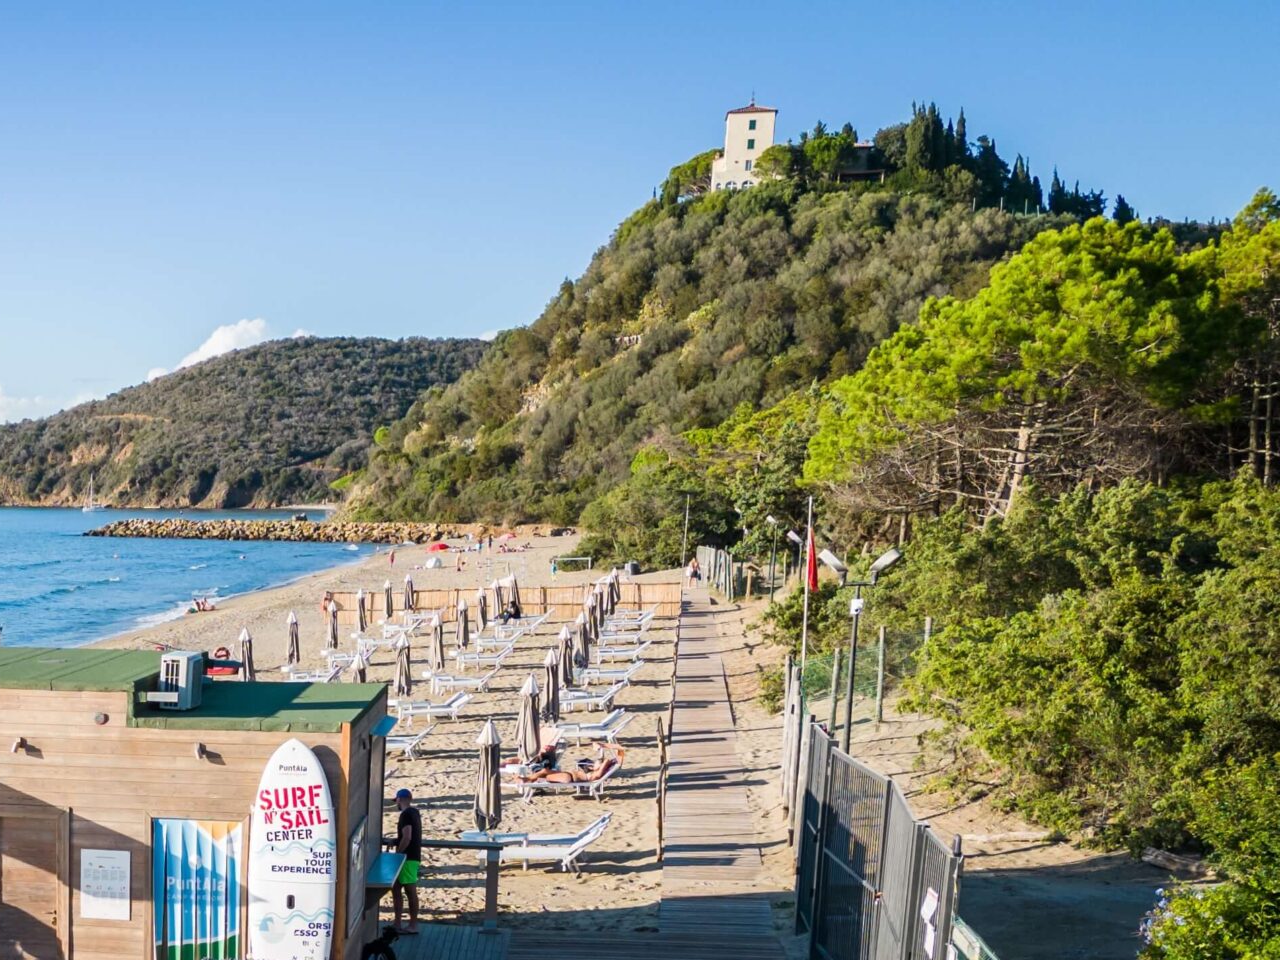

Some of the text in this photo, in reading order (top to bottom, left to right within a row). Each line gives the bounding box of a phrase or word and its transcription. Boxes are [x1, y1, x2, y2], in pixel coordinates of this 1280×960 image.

[259, 785, 322, 810] SURF
[280, 806, 329, 830] SAIL
[266, 829, 313, 842] CENTER
[312, 851, 332, 859] SUP
[304, 859, 332, 867] TOUR
[271, 865, 332, 874] EXPERIENCE
